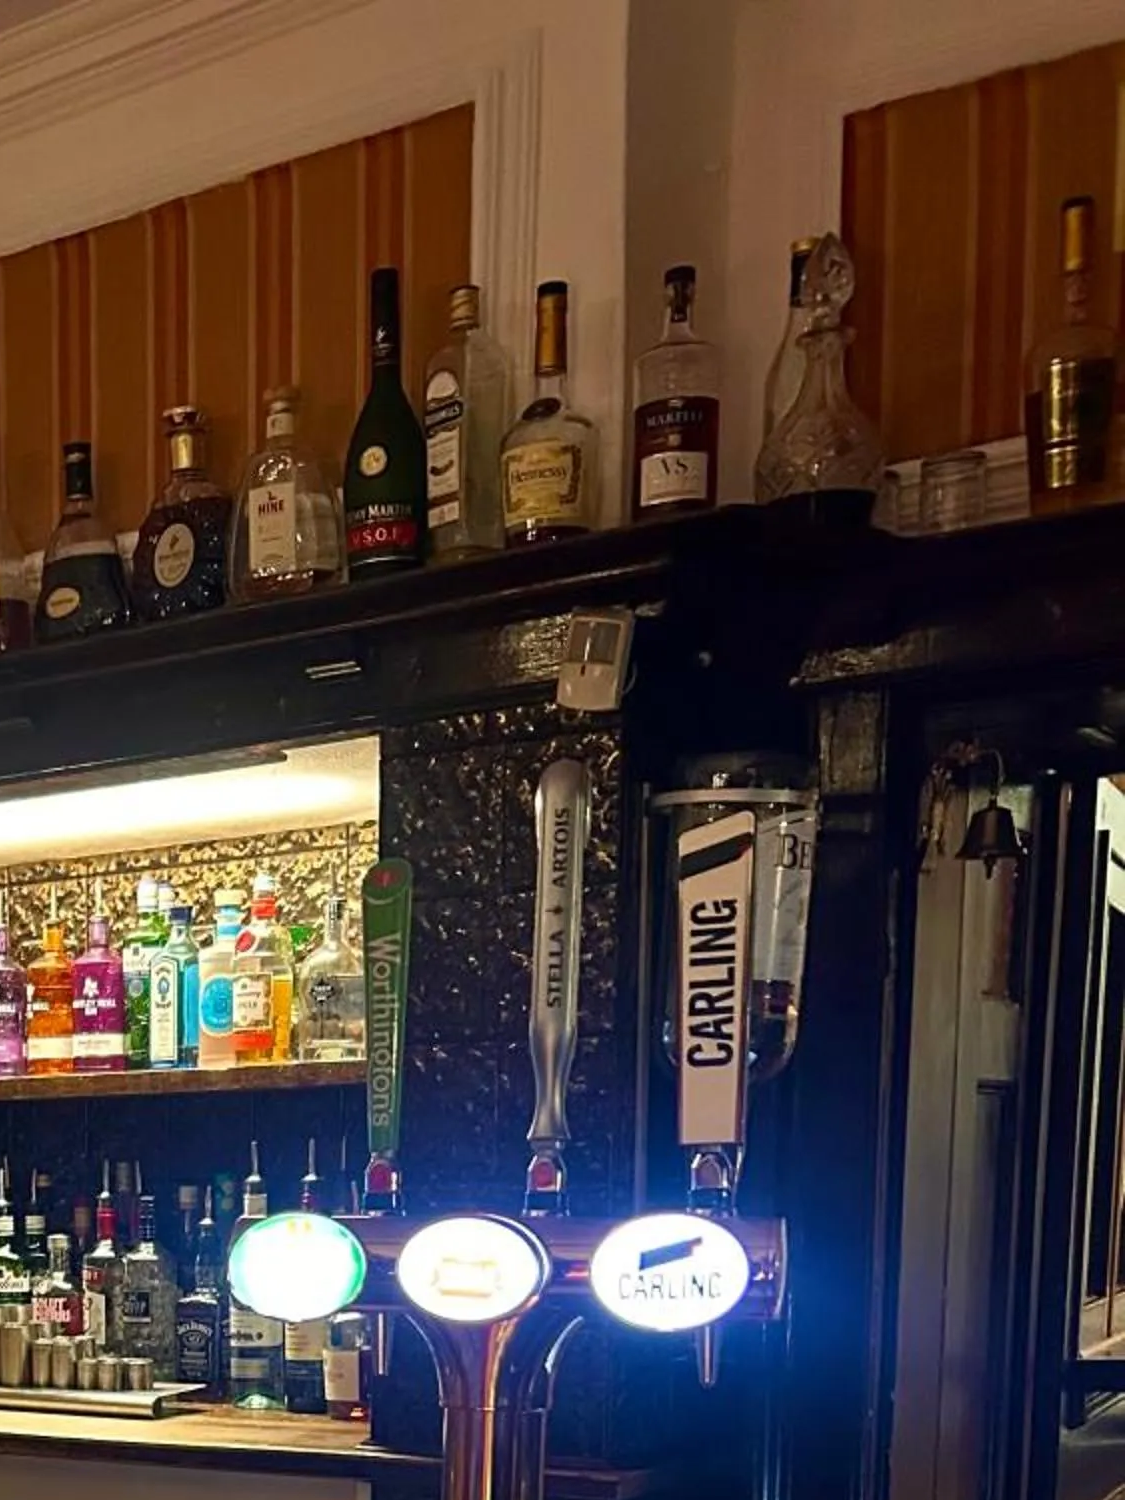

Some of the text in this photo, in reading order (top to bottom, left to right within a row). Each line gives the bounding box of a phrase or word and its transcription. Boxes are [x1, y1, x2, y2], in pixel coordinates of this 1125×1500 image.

[258, 500, 284, 516] HINE
[546, 807, 570, 1008] STELLA ARTOIS
[686, 898, 739, 1069] CARLING
[618, 1270, 723, 1301] CARLING
